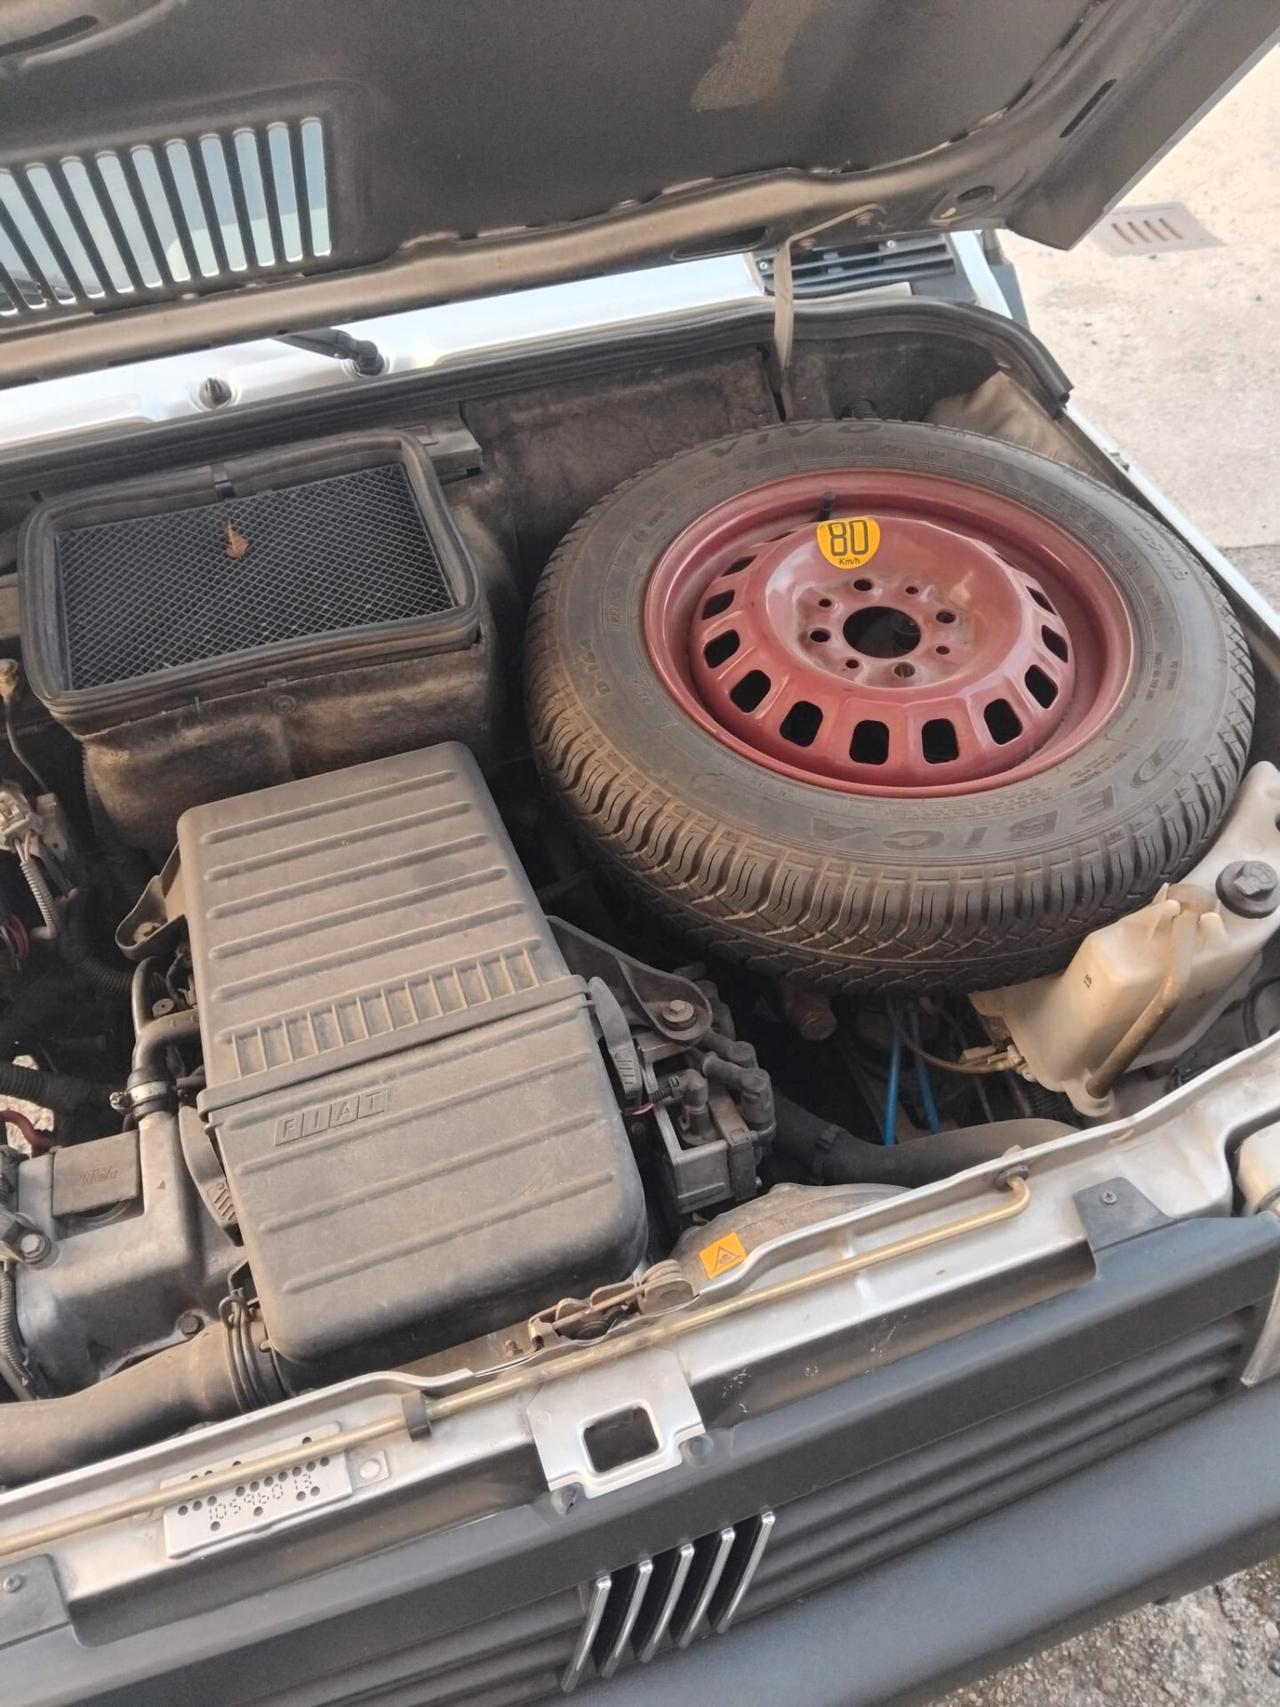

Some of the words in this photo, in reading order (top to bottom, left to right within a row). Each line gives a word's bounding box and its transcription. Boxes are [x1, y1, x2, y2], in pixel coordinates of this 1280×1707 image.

[709, 423, 881, 458] VIVO
[827, 519, 870, 557] 80
[838, 557, 861, 567] Km/h
[279, 1089, 384, 1140] FIAT
